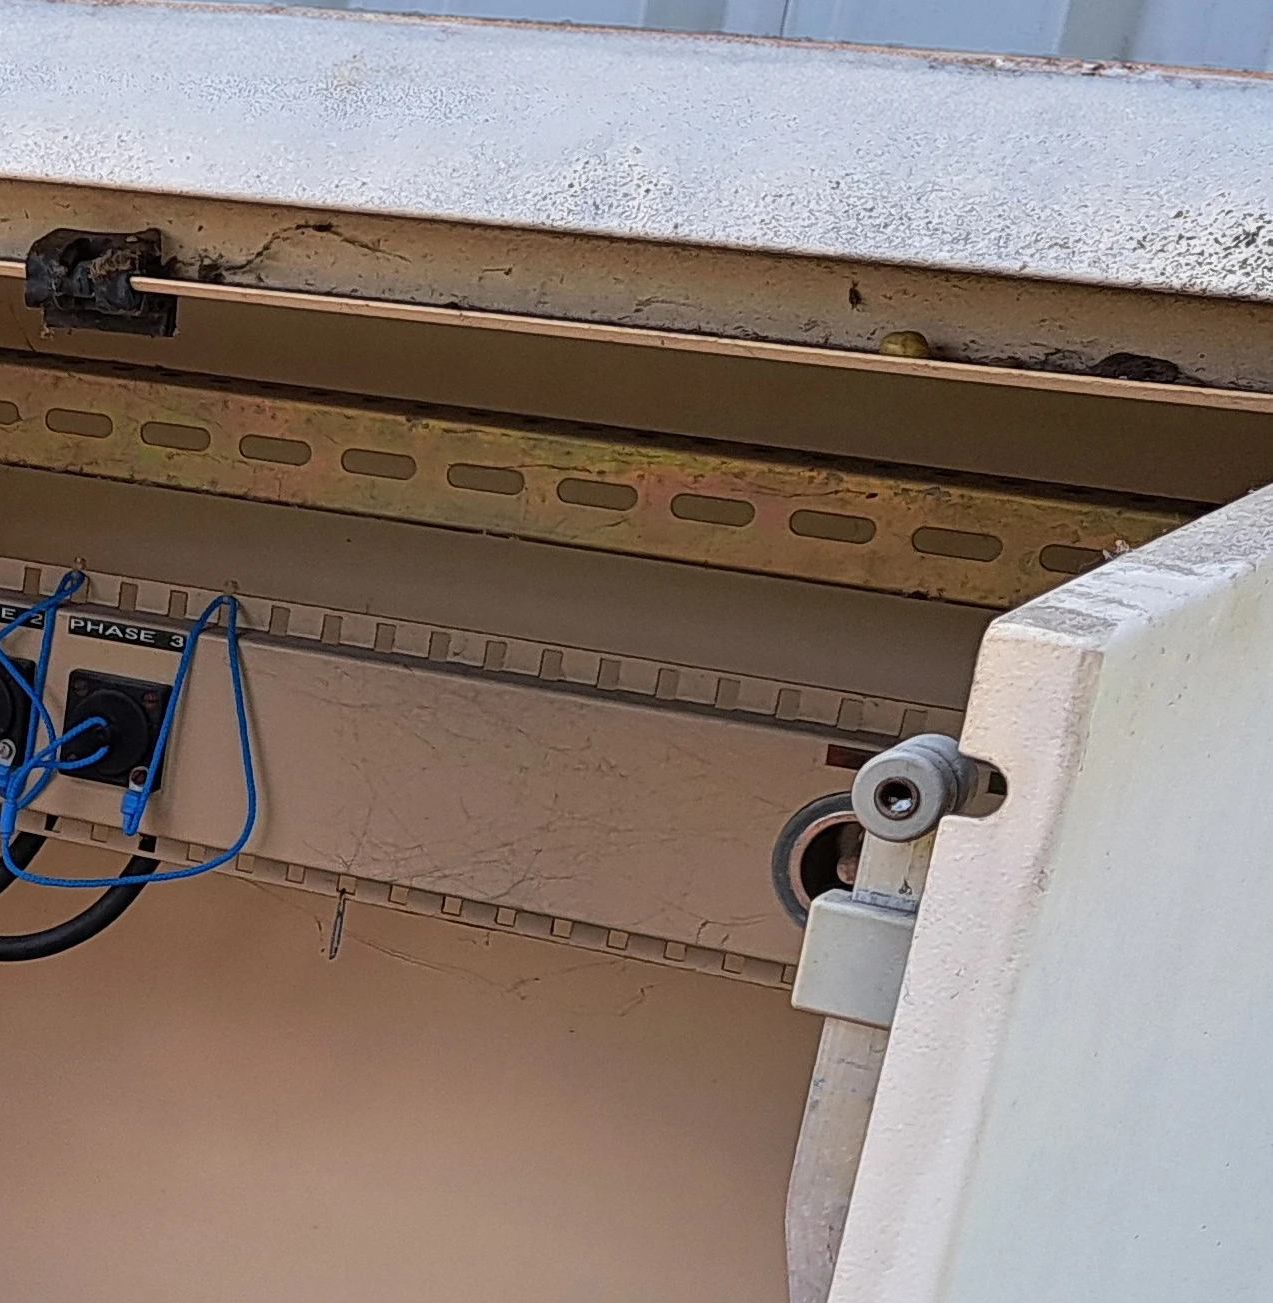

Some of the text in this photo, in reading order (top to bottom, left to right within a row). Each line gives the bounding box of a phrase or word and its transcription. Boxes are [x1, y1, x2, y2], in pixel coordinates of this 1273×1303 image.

[30, 613, 43, 625] 2
[70, 618, 184, 648] PHASE 3
